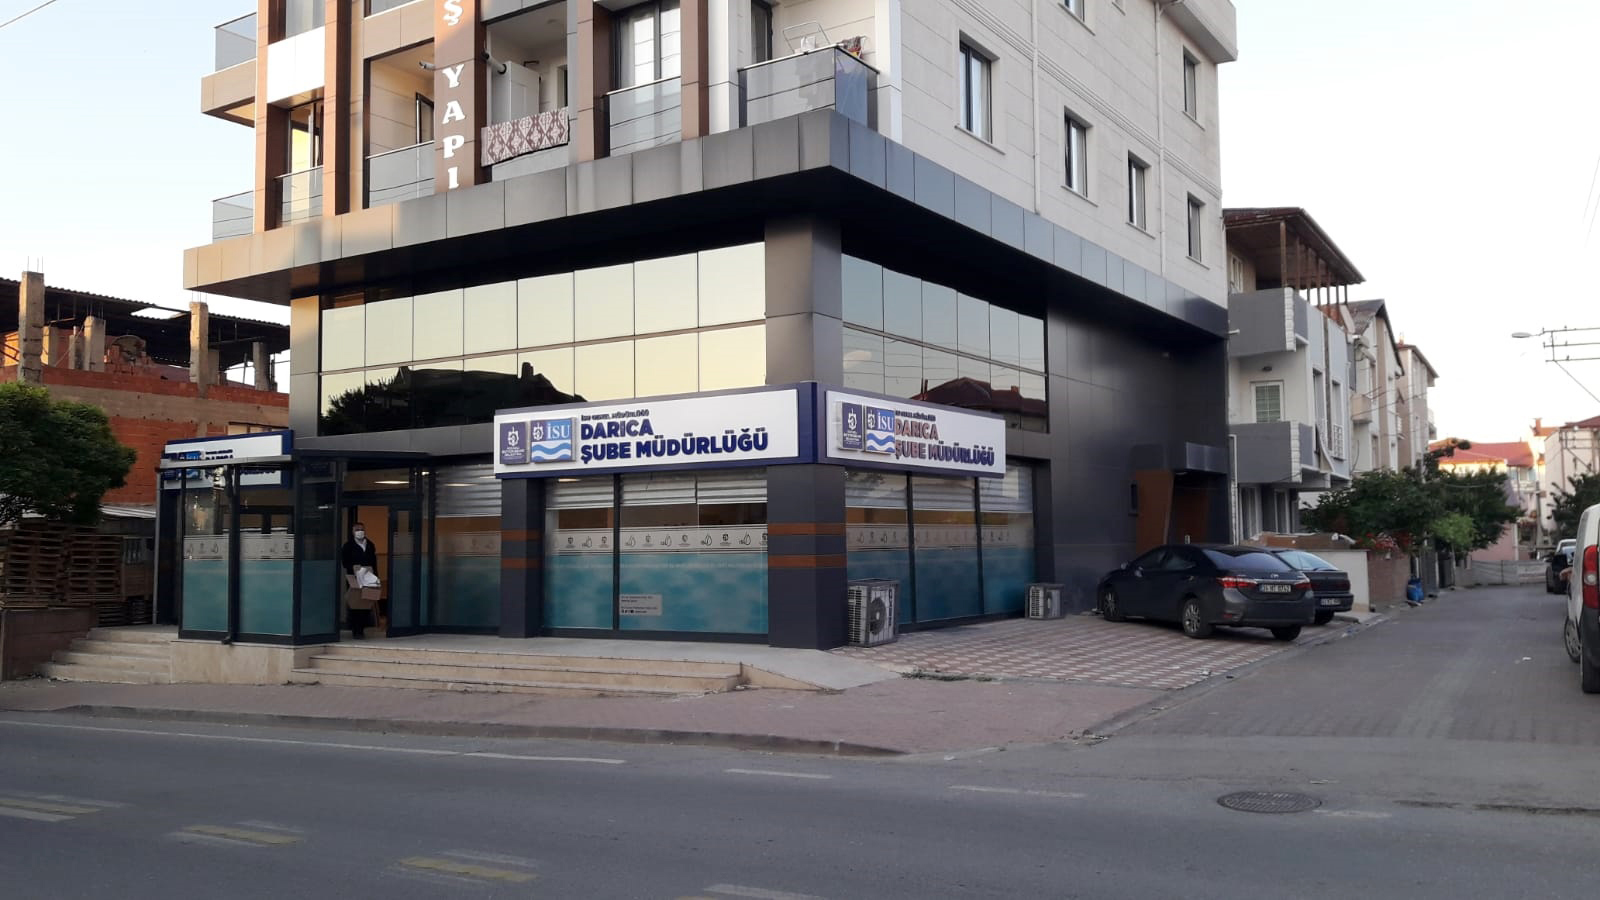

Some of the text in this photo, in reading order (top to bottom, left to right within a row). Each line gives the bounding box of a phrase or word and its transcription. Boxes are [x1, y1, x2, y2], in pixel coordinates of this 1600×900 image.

[442, 63, 465, 190] YAPI
[547, 423, 571, 440] İSU
[580, 418, 653, 440] DARICA
[877, 411, 894, 432] İSU
[895, 419, 939, 441] DARICA
[580, 427, 768, 464] ŞUBE MÜDÜRLÜĞÜ
[895, 440, 995, 467] ŞUBE MÜDÜRLÜĞÜ
